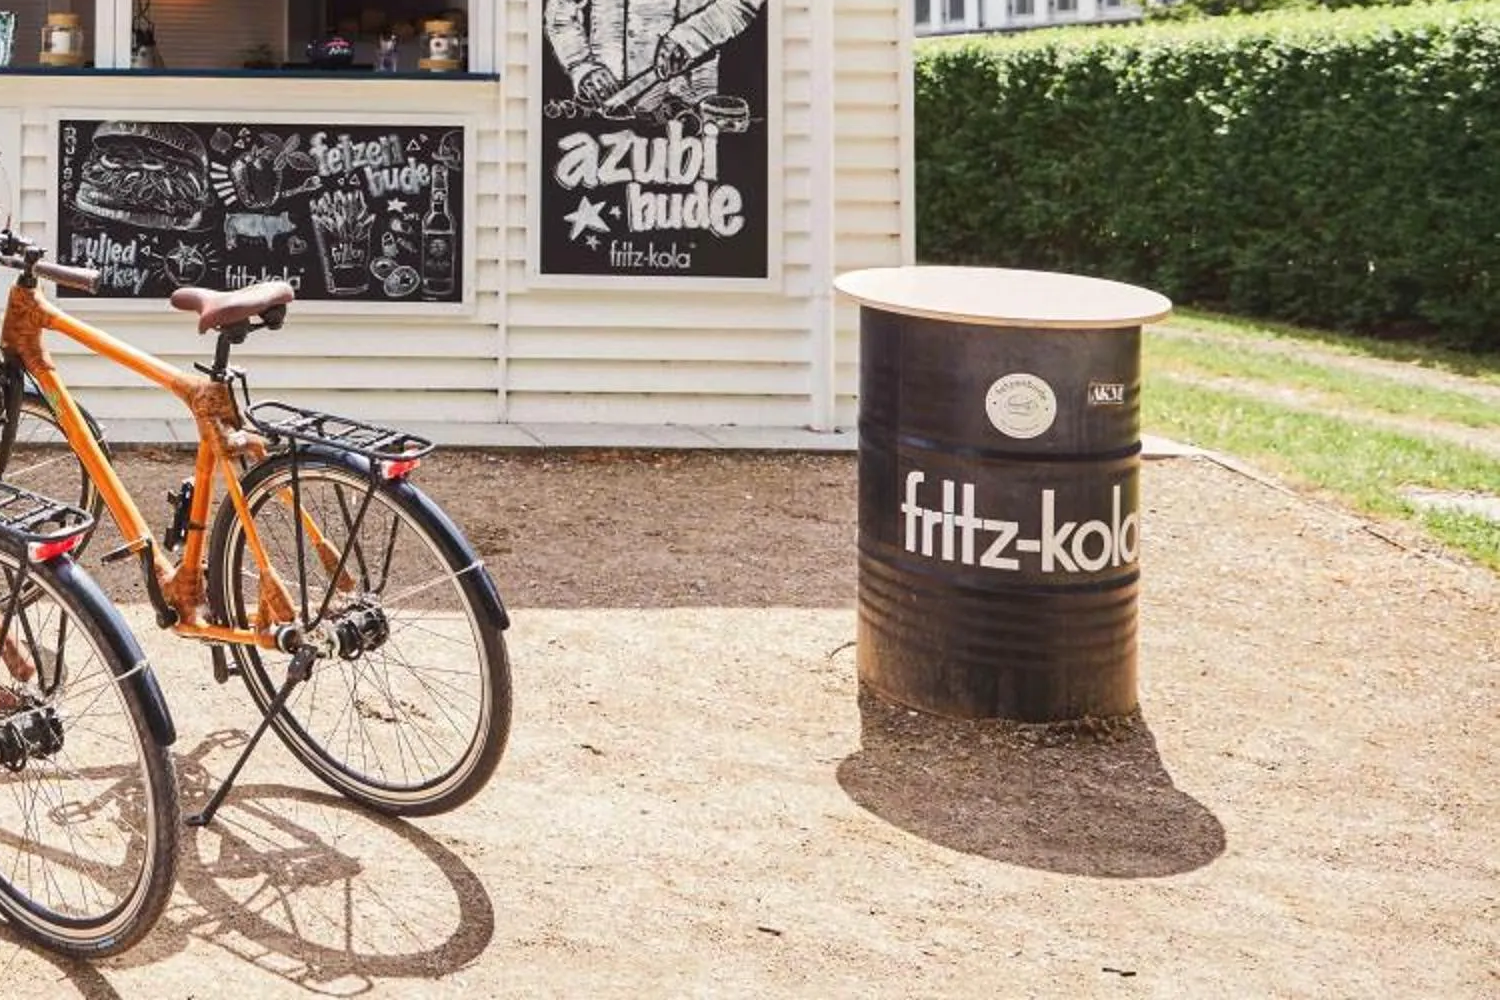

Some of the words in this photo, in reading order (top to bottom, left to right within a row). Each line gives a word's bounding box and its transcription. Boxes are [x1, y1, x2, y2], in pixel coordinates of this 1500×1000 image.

[309, 132, 403, 178] fetzen
[364, 157, 431, 197] bude
[554, 118, 719, 191] azubi
[626, 180, 746, 238] bude
[84, 258, 149, 295] trkey
[609, 240, 692, 268] fritz-kola
[901, 471, 1140, 572] fritz-kola
